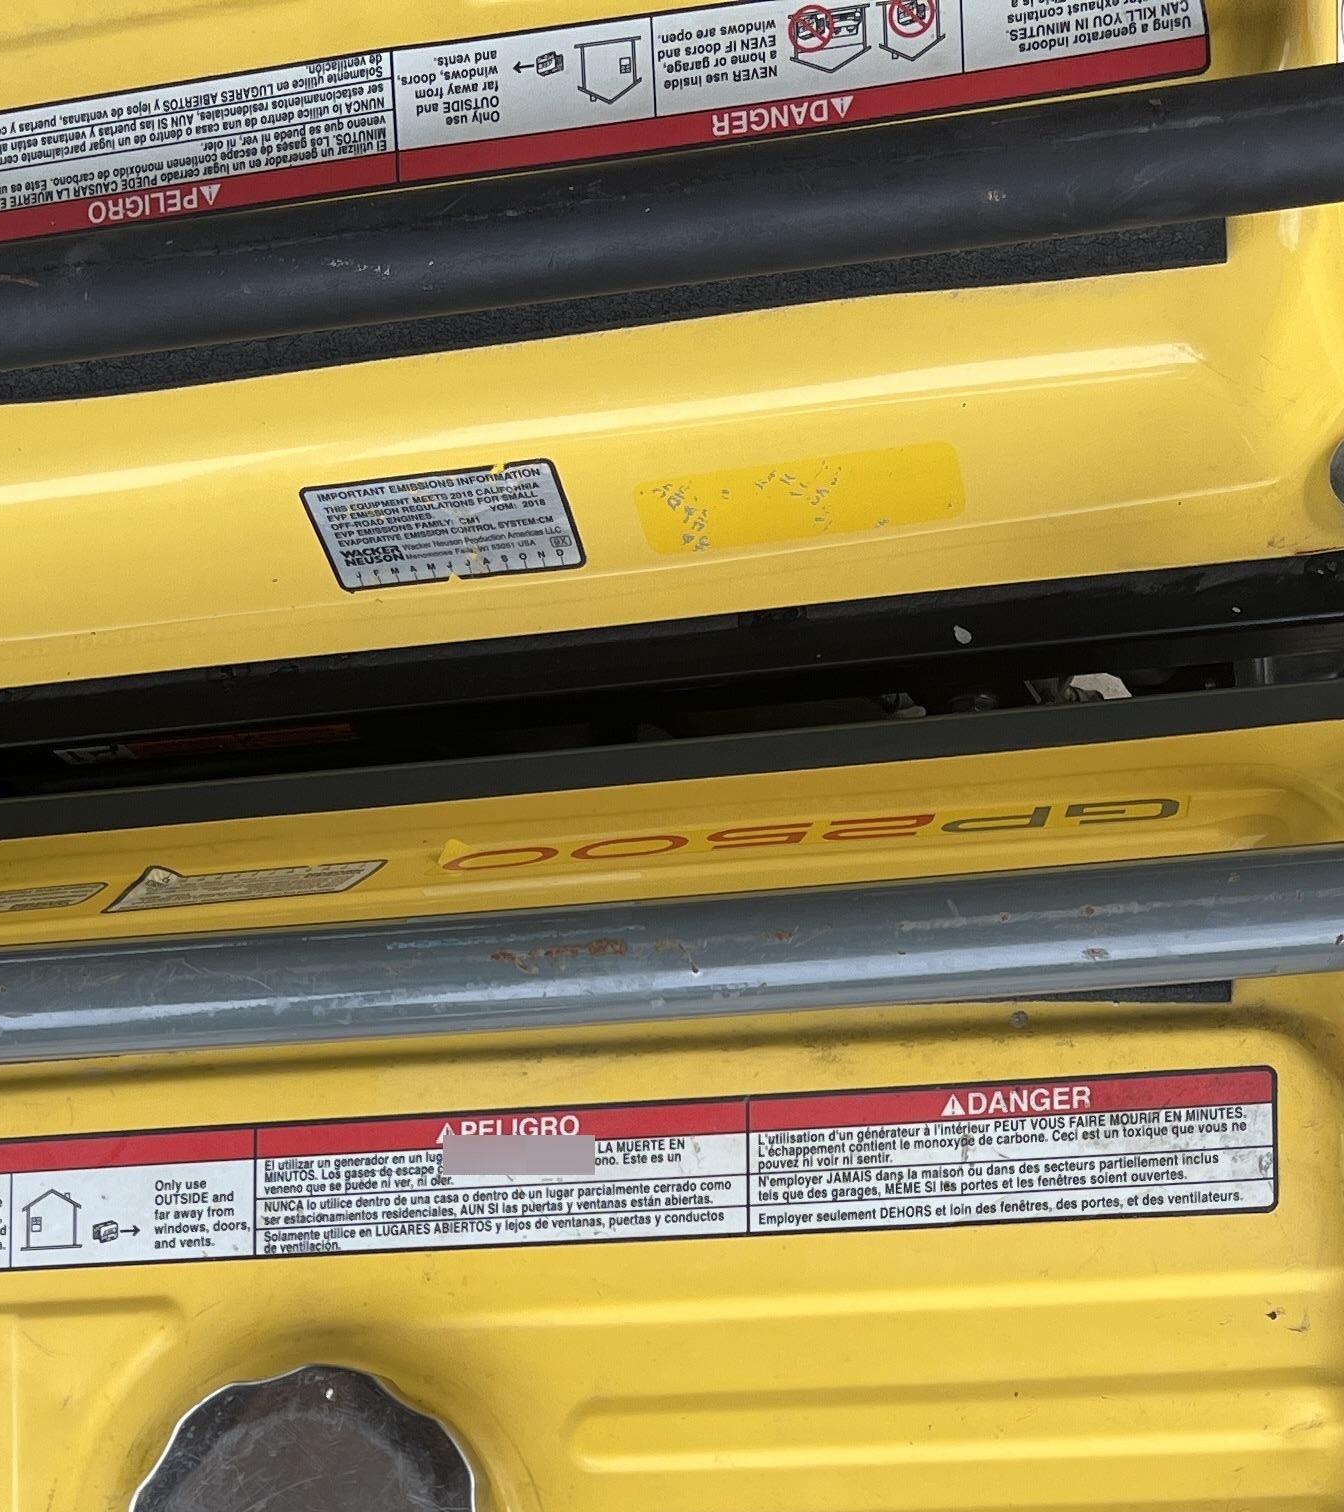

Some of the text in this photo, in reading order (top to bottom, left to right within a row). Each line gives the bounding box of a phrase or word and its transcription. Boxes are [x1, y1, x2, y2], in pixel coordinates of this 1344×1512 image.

[657, 18, 776, 44] windows are open.
[656, 33, 776, 62] EVEN IF doors and
[662, 48, 777, 74] a home or garage,
[663, 64, 778, 91] NEVER use inside
[711, 98, 828, 136] DANGER
[87, 186, 198, 223] PELIGRO
[316, 467, 541, 502] IMPORTANT EMISSIONS INFORMATION
[338, 544, 402, 559] WACKER
[343, 551, 405, 567] NEUSON
[441, 798, 1179, 872] GP2500
[967, 1085, 1090, 1115] DANGER
[460, 1114, 579, 1136] PELIGRO
[757, 1106, 1247, 1146] L'utilisation d'un générateur à l'intérieur PEUT VOUS FAIRE MOURIR EN MINUTES.
[597, 1137, 685, 1154] LA MUERTE EN
[263, 1153, 423, 1172] El utilizar un generador en un
[154, 1178, 207, 1193] Only use
[154, 1190, 234, 1206] OUTSIDE and
[263, 1179, 731, 1212] NUNCA lo utilice dentro de una casa o dentro de un lugar parcialmente cerrado como
[153, 1205, 234, 1221] far away from
[758, 1190, 1243, 1227] Employer seulement DEHORS et loin des fenêtres, des portes, et des ventilateurs.
[153, 1220, 250, 1235] windows, doors,
[153, 1235, 215, 1249] and vents.
